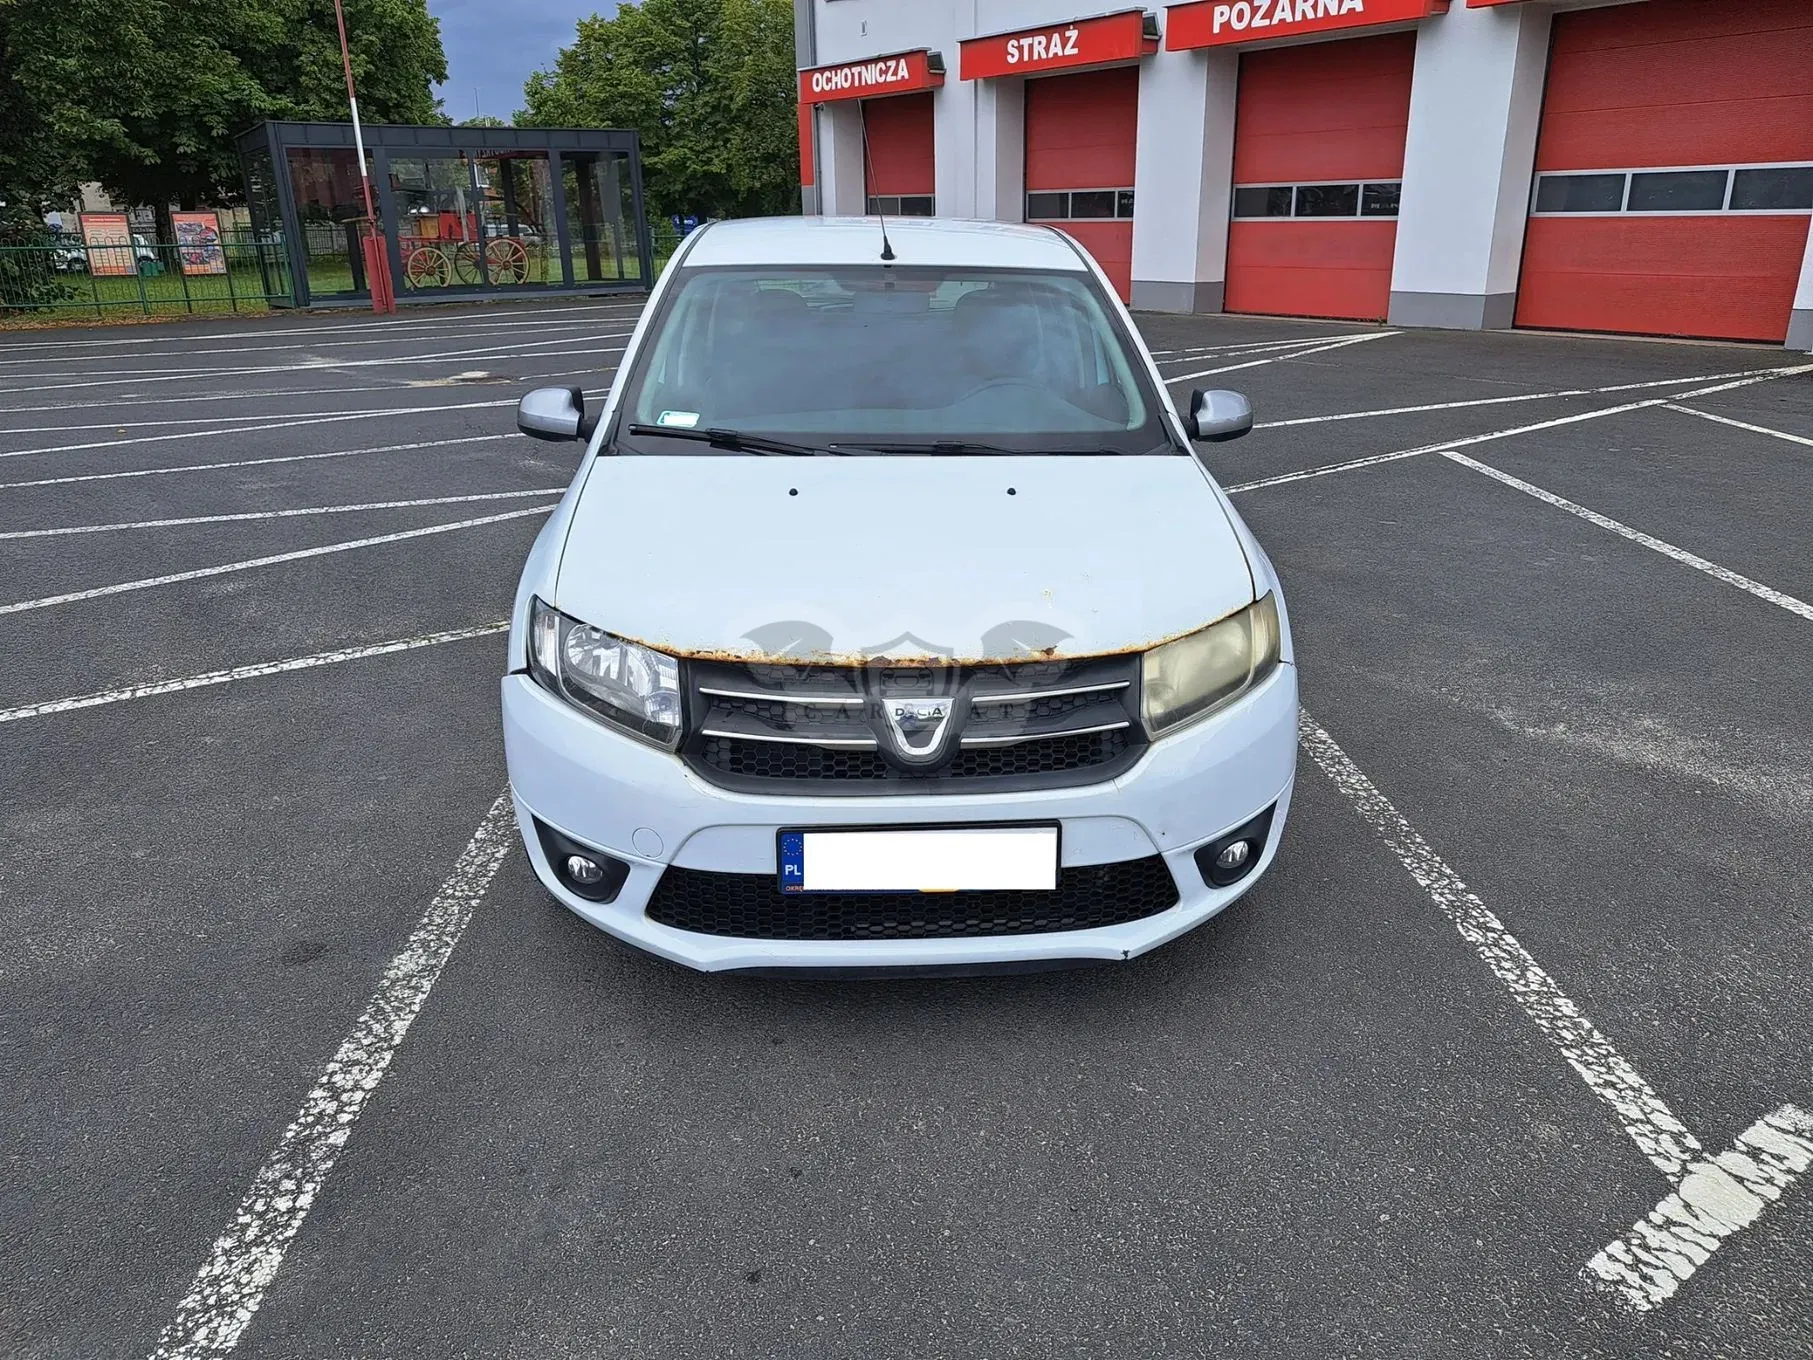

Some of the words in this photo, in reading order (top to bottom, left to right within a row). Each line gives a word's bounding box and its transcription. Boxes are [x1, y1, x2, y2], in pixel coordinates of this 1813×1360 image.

[1006, 25, 1079, 64] STRAŻ
[812, 58, 909, 93] OCHOTNICZA
[785, 864, 802, 876] PL
